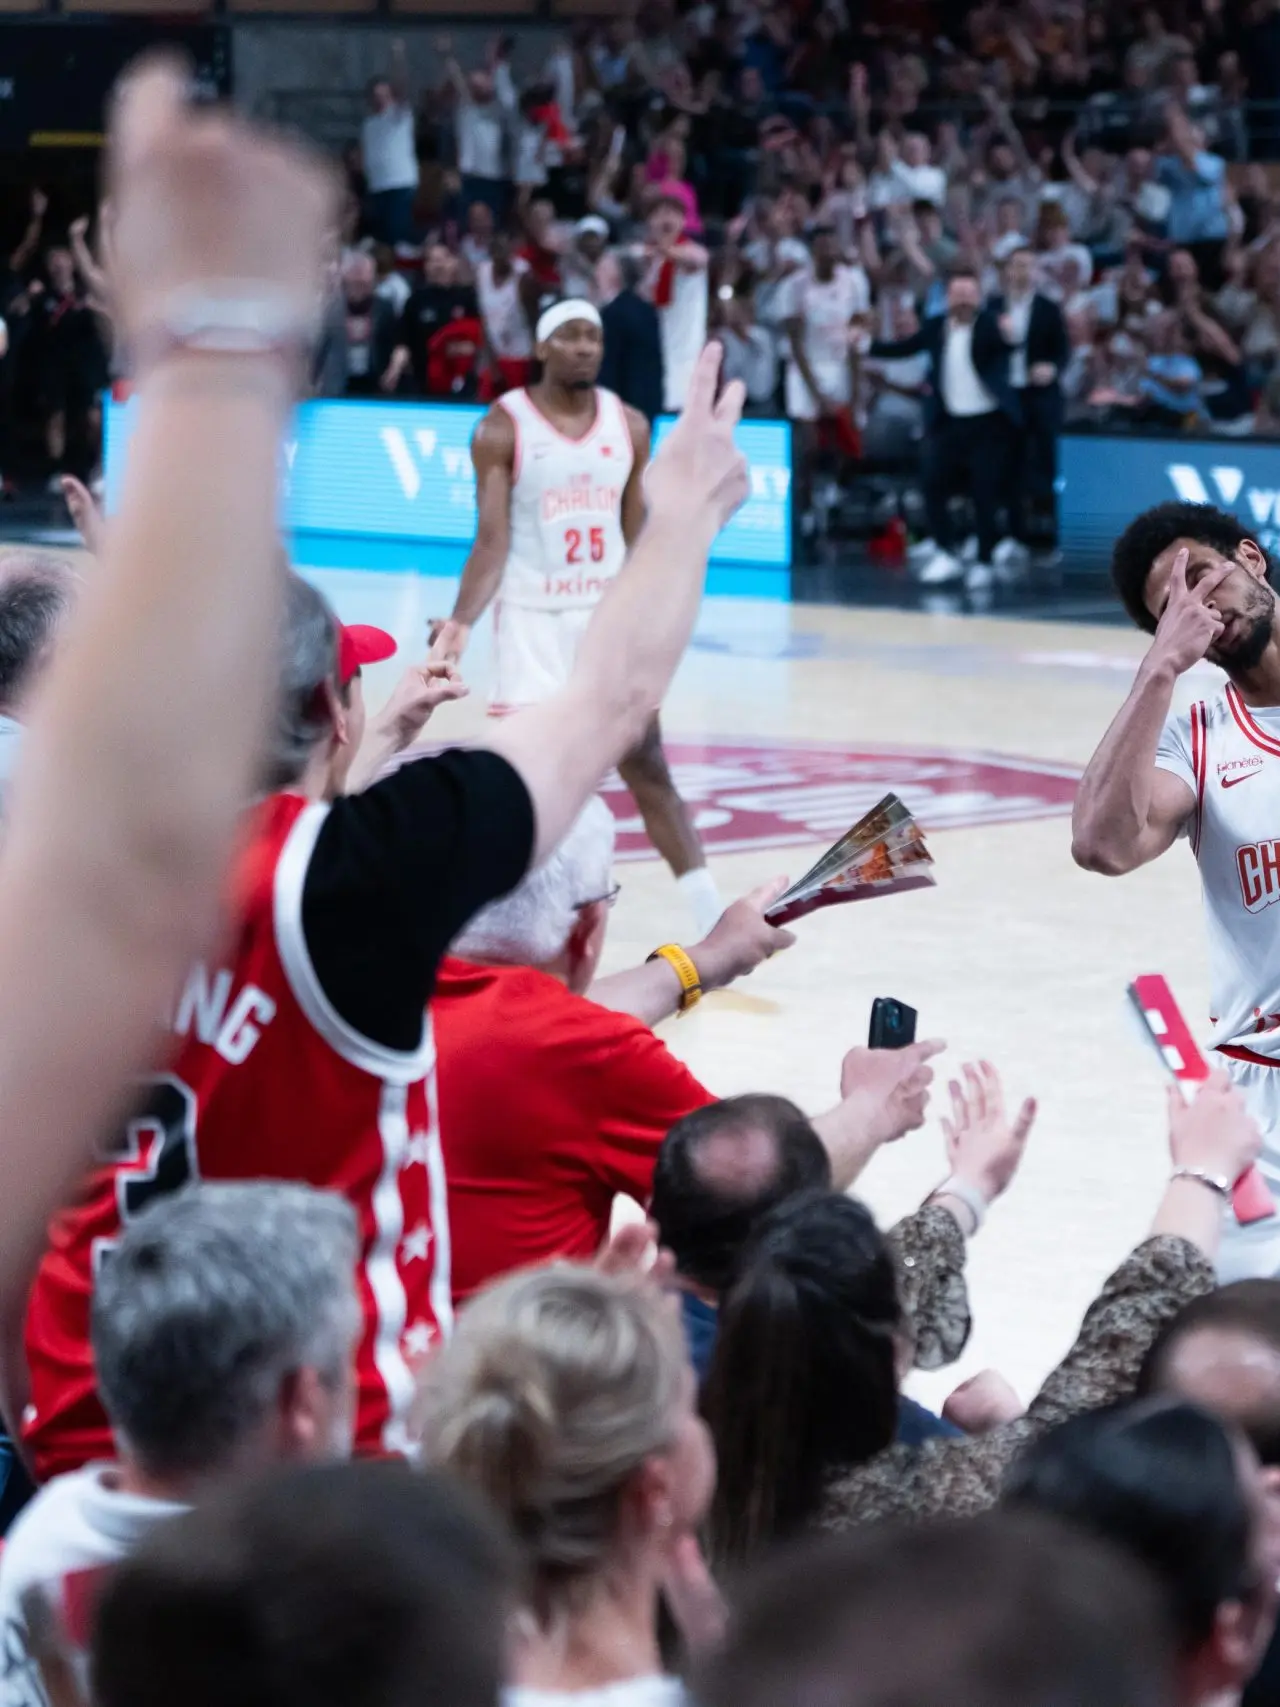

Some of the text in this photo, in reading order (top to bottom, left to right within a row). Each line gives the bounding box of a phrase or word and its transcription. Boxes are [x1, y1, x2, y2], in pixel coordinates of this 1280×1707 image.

[564, 527, 605, 565] 25
[545, 570, 608, 596] ixin
[174, 959, 277, 1065] NG
